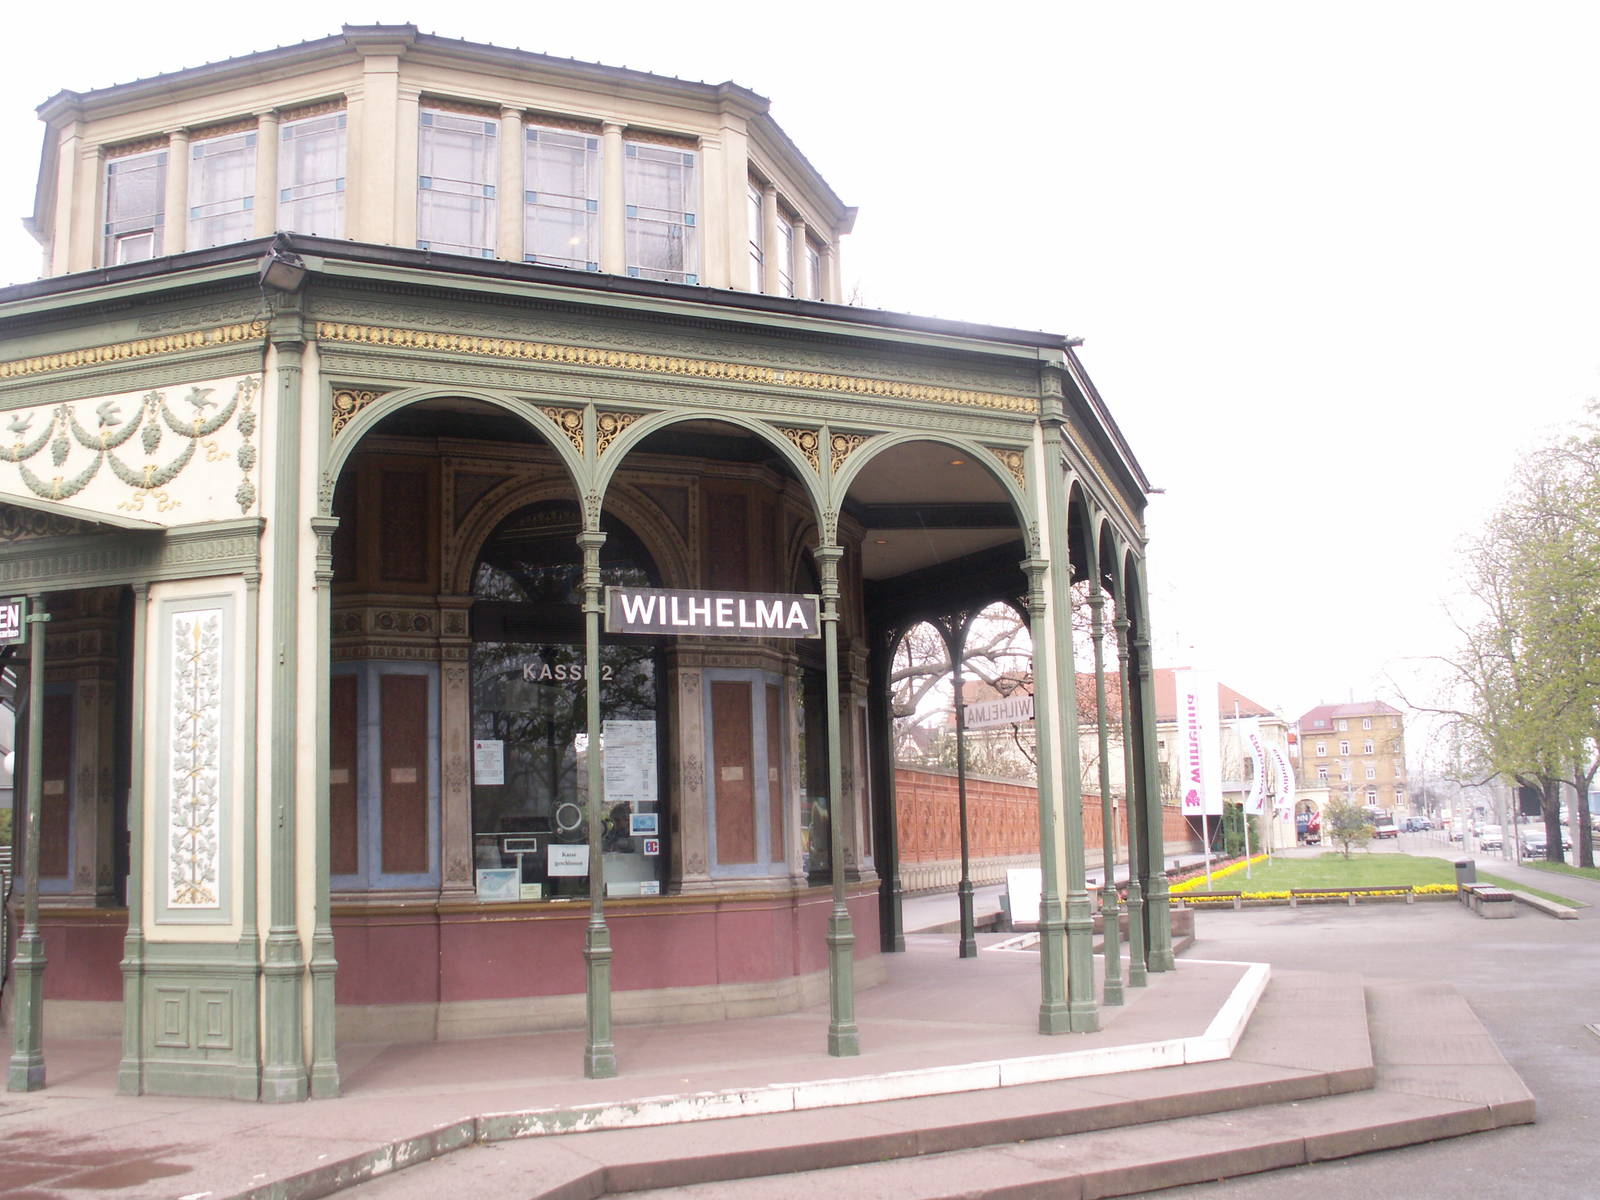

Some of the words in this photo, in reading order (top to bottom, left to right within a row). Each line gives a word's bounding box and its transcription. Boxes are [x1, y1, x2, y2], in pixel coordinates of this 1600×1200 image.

[621, 594, 809, 630] WILHELMA
[523, 663, 588, 681] KASS
[602, 665, 613, 681] 2
